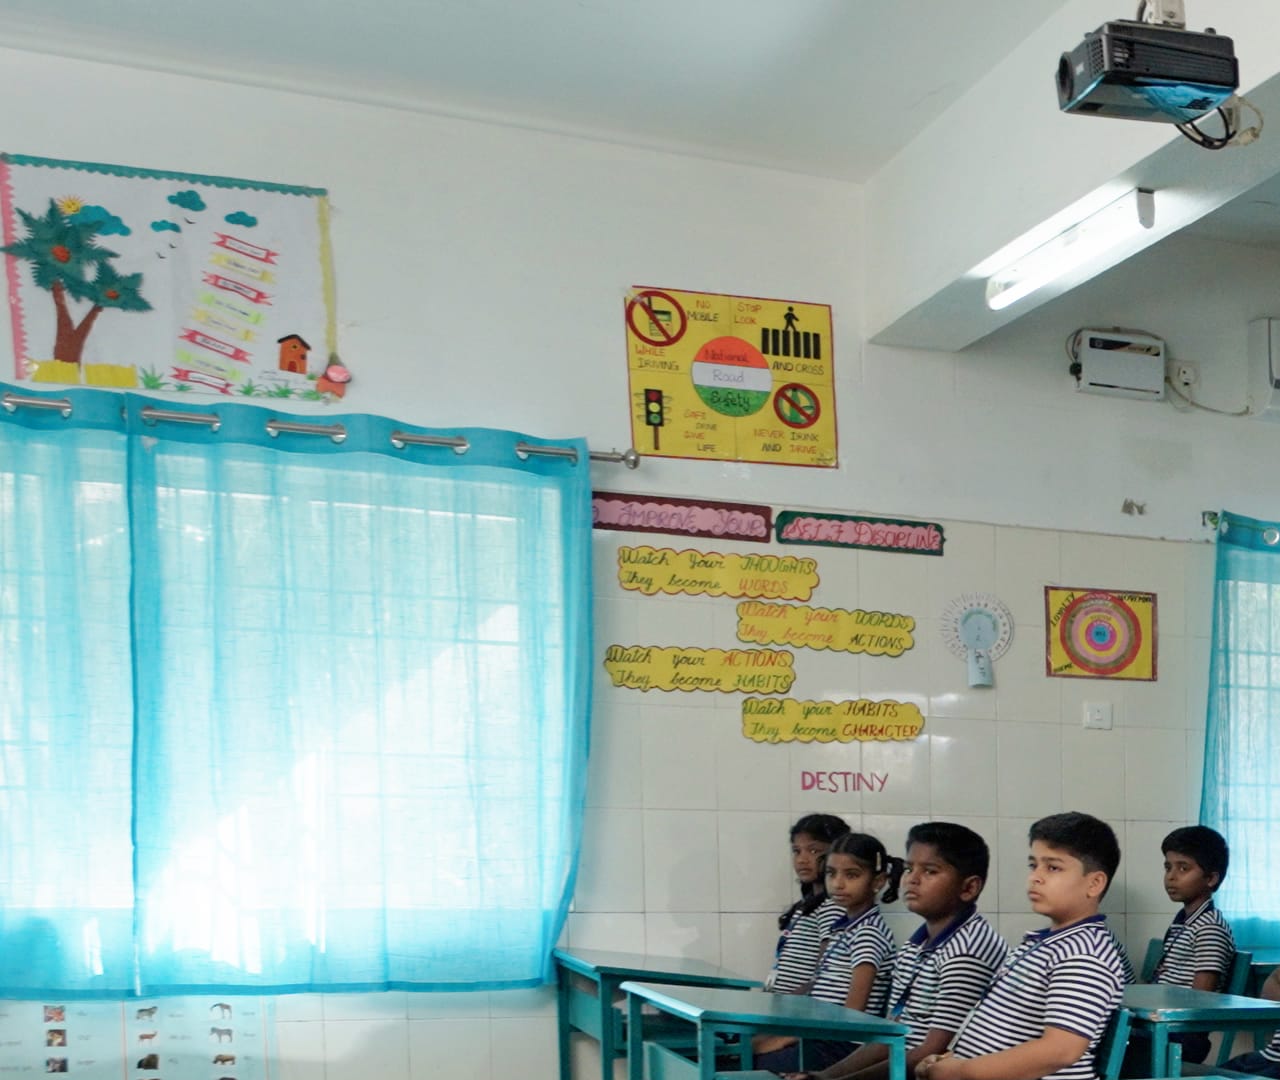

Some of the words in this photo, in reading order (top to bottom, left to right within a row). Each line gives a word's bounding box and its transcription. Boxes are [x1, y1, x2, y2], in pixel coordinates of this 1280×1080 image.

[696, 300, 710, 309] NO
[737, 303, 762, 312] STOP
[687, 311, 718, 322] MOBILE
[734, 315, 757, 324] LOOK
[635, 344, 665, 356] WHILE
[704, 349, 748, 362] National
[772, 362, 793, 371] AND
[795, 365, 824, 375] CROSS
[712, 370, 744, 383] Road
[710, 390, 751, 413] Safety
[754, 429, 784, 439] NEVER
[697, 444, 716, 452] LIFE
[761, 444, 781, 452] AND
[618, 504, 697, 531] IMPROVE
[716, 510, 764, 535] YOUR
[854, 523, 941, 549] DISCIPLINE
[621, 549, 669, 566] Watch
[739, 557, 814, 575] THOUGHTS
[622, 570, 653, 588] They
[669, 575, 722, 589] become
[738, 577, 788, 593] WORDS
[741, 602, 788, 619] Watch
[854, 611, 909, 629] WORDS
[740, 623, 768, 641] They
[785, 629, 833, 644] become
[850, 633, 905, 649] ACTIONS
[607, 648, 651, 663] Watch
[721, 651, 789, 667] ACTIONS
[616, 669, 650, 686] They
[671, 672, 723, 686] become
[732, 673, 790, 689] HABITS
[743, 700, 786, 715] Watch
[843, 703, 898, 717] HABITS
[749, 722, 779, 737] They
[791, 723, 836, 737] become
[842, 725, 918, 737] CHARACTER
[801, 771, 888, 792] DESTINY
